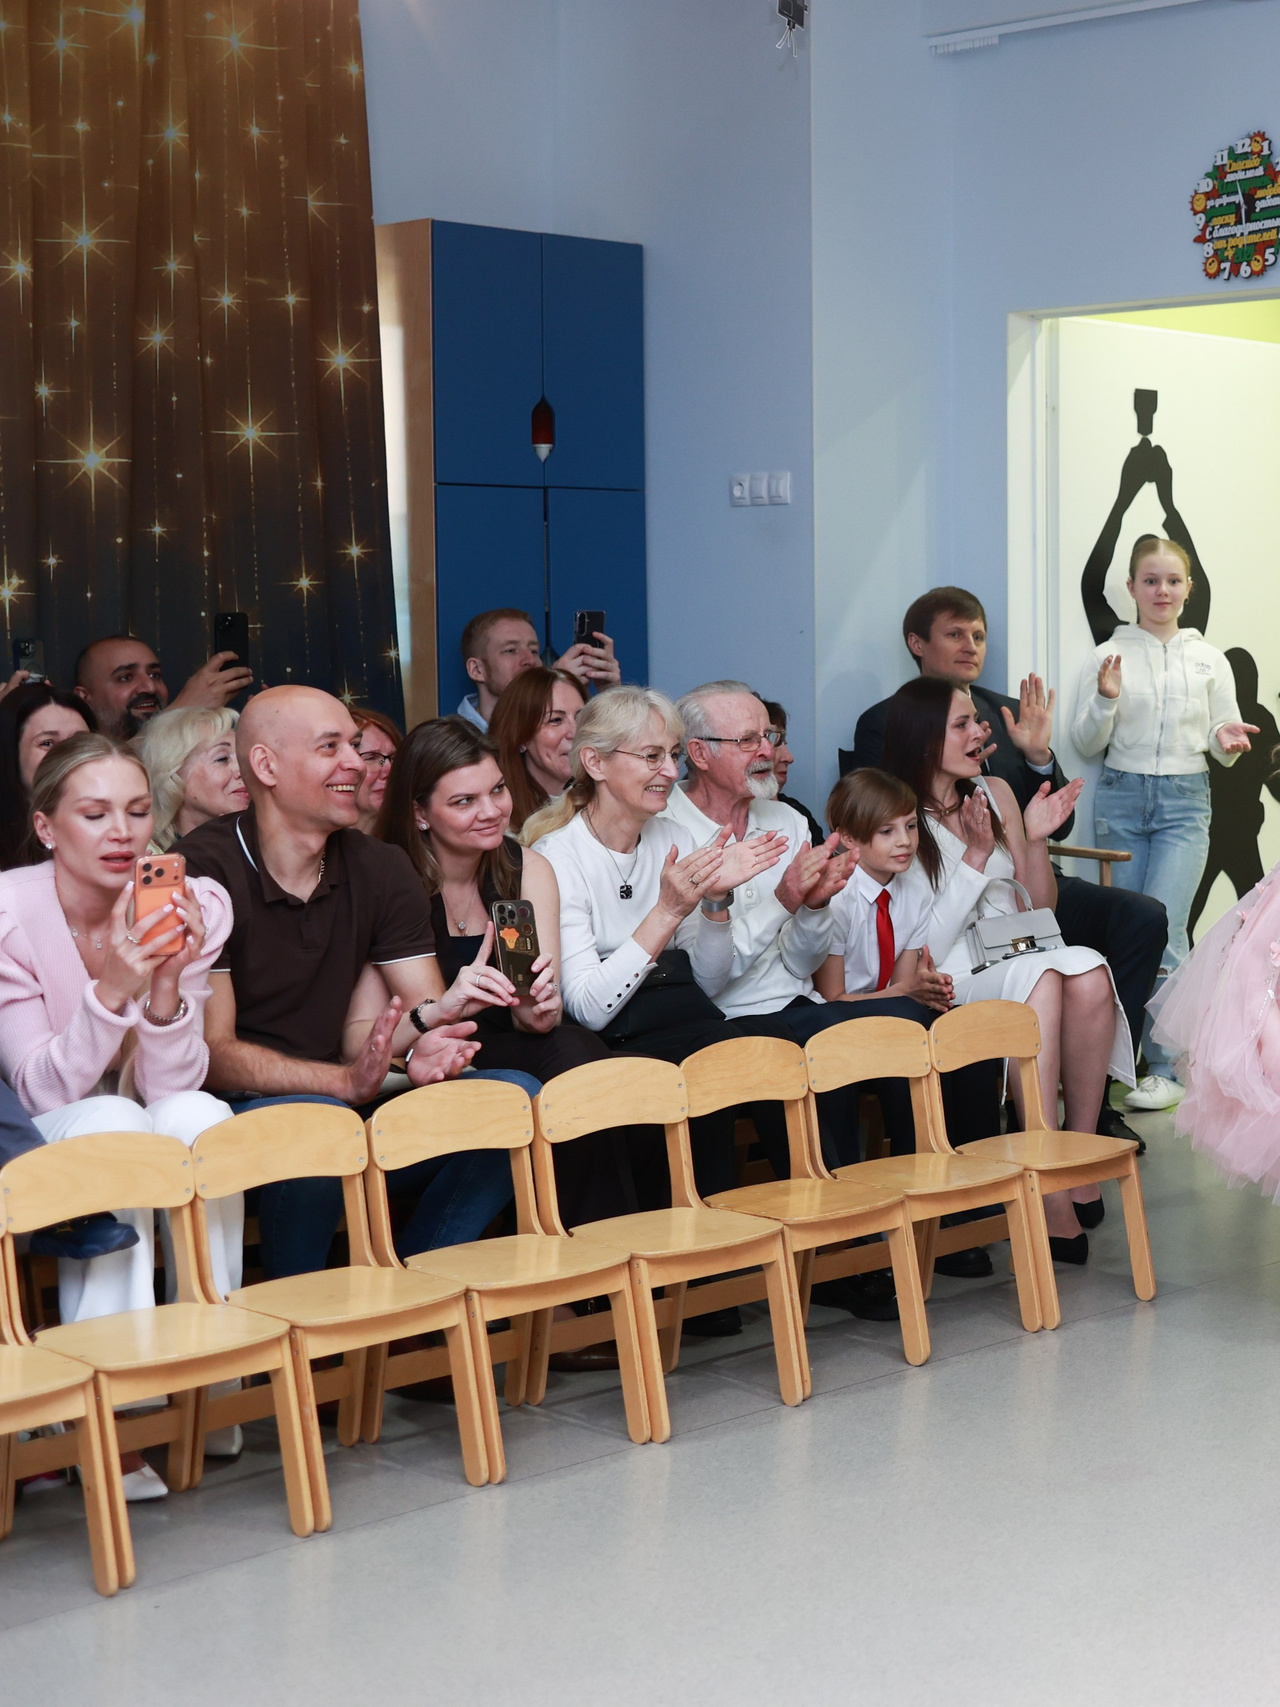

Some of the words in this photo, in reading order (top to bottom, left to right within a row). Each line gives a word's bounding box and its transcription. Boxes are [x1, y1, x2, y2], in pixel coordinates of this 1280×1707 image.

[1235, 138, 1251, 154] 12
[1261, 139, 1271, 156] 1
[1214, 149, 1229, 166] 11
[1226, 154, 1261, 172] Спасибо
[1197, 177, 1214, 193] 10
[1194, 213, 1206, 230] 9
[1202, 242, 1214, 258] 8
[1264, 247, 1276, 265] 5
[1220, 262, 1231, 279] 7
[1240, 261, 1251, 278] 6
